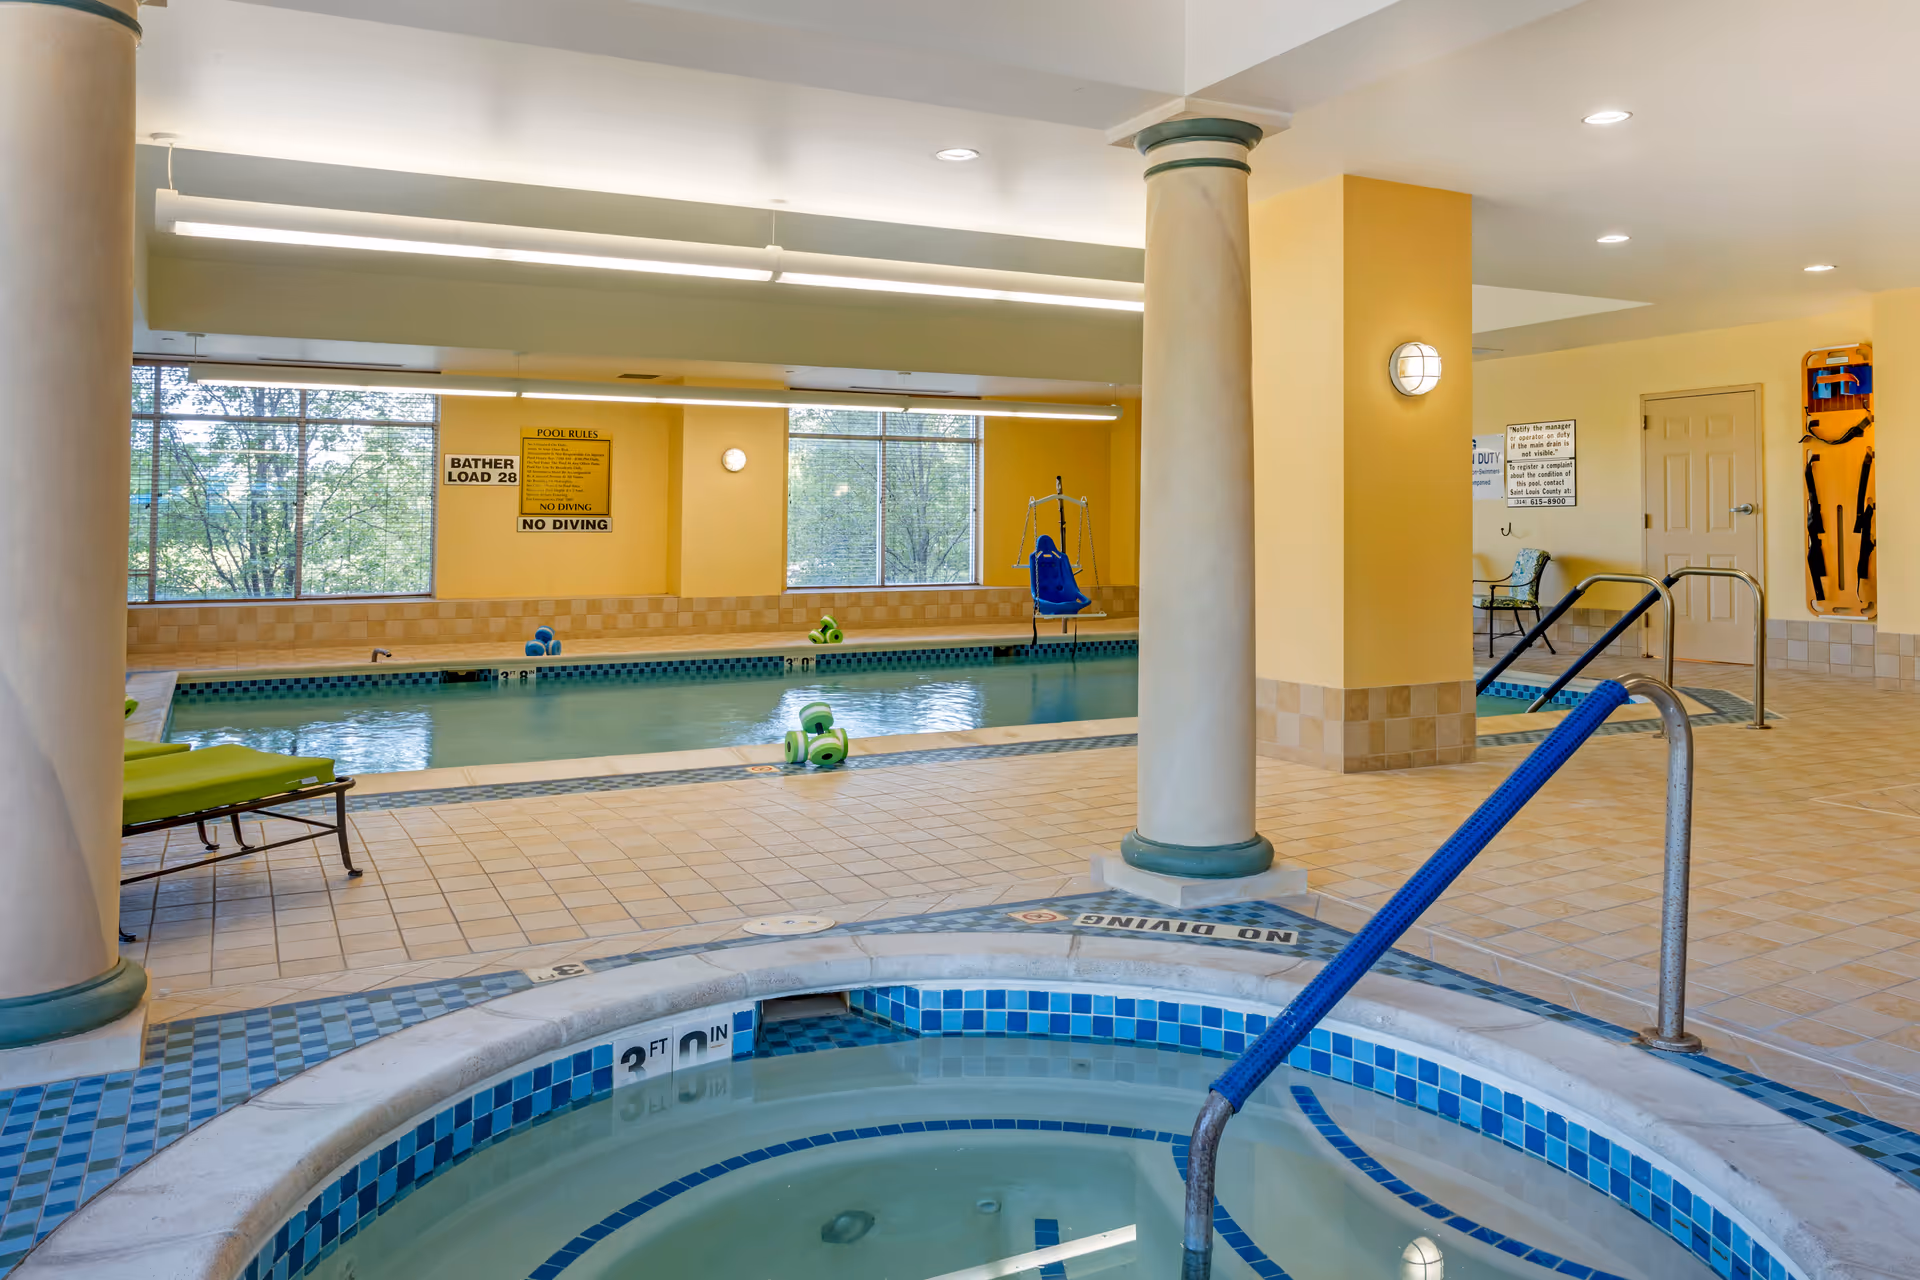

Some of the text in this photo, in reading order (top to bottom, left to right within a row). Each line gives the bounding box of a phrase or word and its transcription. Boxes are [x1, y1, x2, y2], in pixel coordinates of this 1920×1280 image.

[537, 428, 599, 439] POOL RULES
[1519, 433, 1544, 441] operator
[1477, 451, 1501, 464] DUTY
[450, 457, 515, 470] BATHER
[1546, 461, 1573, 469] complaint
[447, 470, 518, 483] LOAD 28
[1538, 470, 1563, 478] condition
[1542, 487, 1561, 495] County
[539, 502, 592, 511] NO DIVING
[522, 519, 608, 530] NO DIVING
[1079, 914, 1293, 943] NO DIVING
[620, 1046, 647, 1073] 3
[649, 1037, 668, 1057] FT
[710, 1023, 728, 1043] IN
